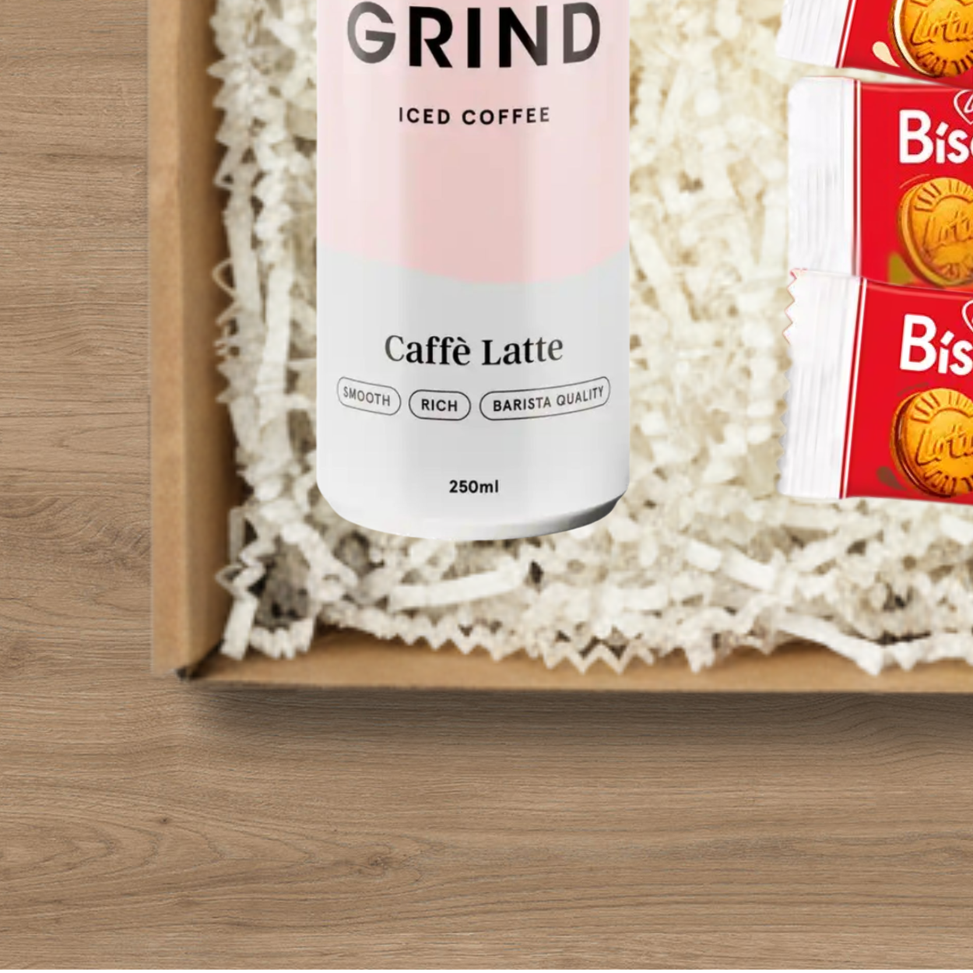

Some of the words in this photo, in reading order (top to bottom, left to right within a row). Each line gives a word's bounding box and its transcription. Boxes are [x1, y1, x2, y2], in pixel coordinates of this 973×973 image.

[347, 1, 600, 68] GRIND
[398, 107, 450, 124] ICED
[462, 107, 549, 125] COFFEE
[385, 335, 470, 366] Caffè
[481, 338, 562, 365] Latte
[343, 386, 391, 407] SMOOTH
[421, 399, 457, 411] RICH
[493, 397, 551, 412] BARISTA
[556, 385, 604, 407] QUALITY
[449, 480, 498, 493] 250ml
